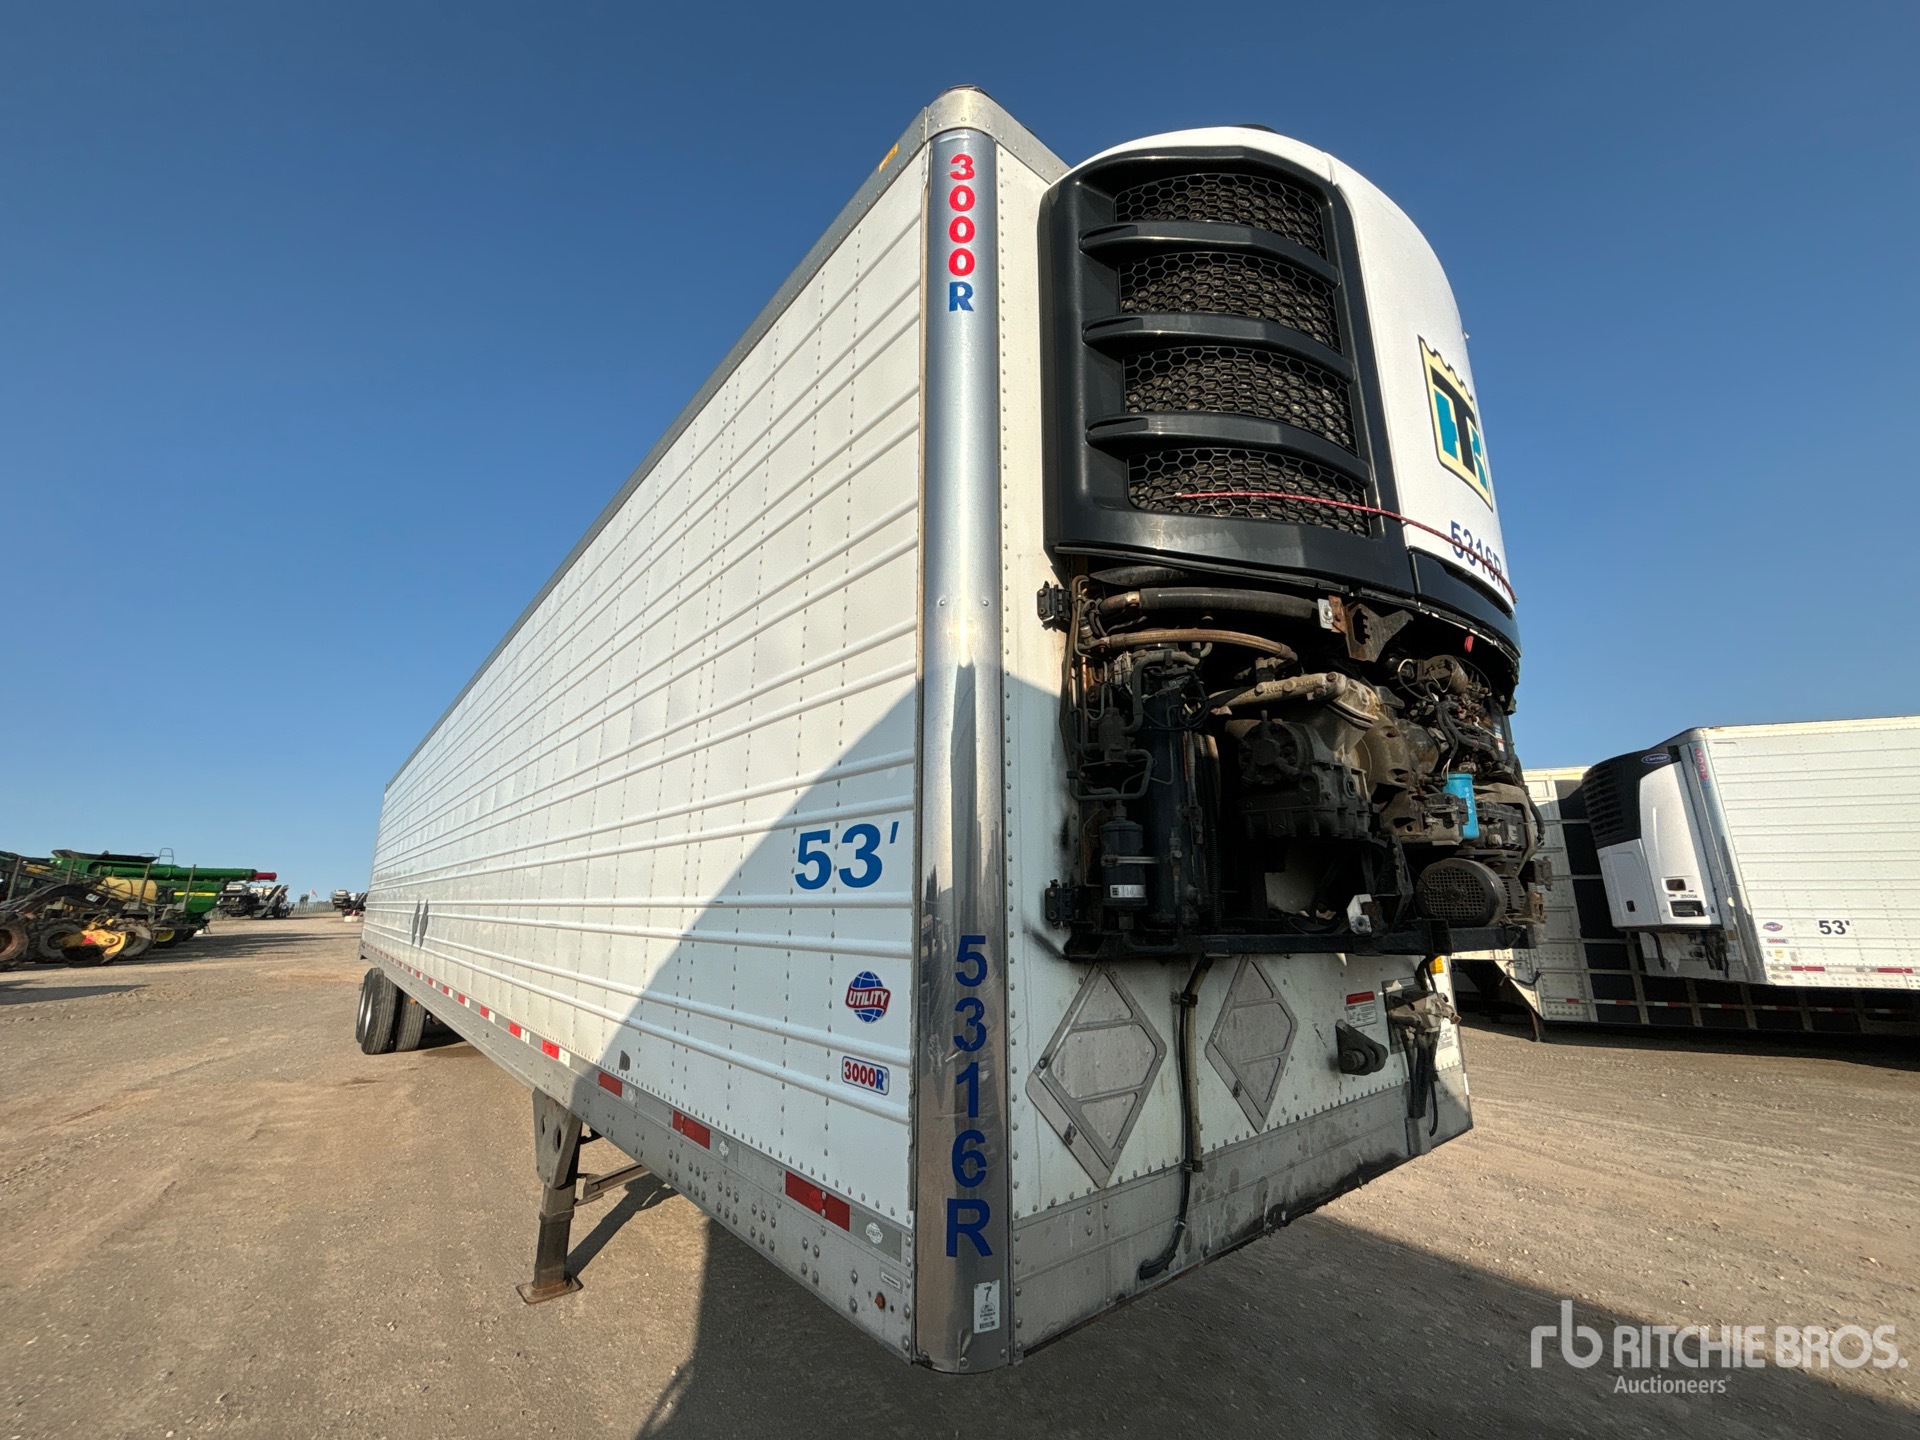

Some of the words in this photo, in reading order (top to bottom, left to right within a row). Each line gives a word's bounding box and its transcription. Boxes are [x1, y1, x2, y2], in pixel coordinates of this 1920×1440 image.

[948, 153, 976, 312] 3000R
[1450, 519, 1506, 593] 5316R
[795, 821, 899, 890] 53'
[847, 989, 889, 1008] UTILITY
[945, 935, 993, 1258] 5316R
[983, 1286, 992, 1302] 7
